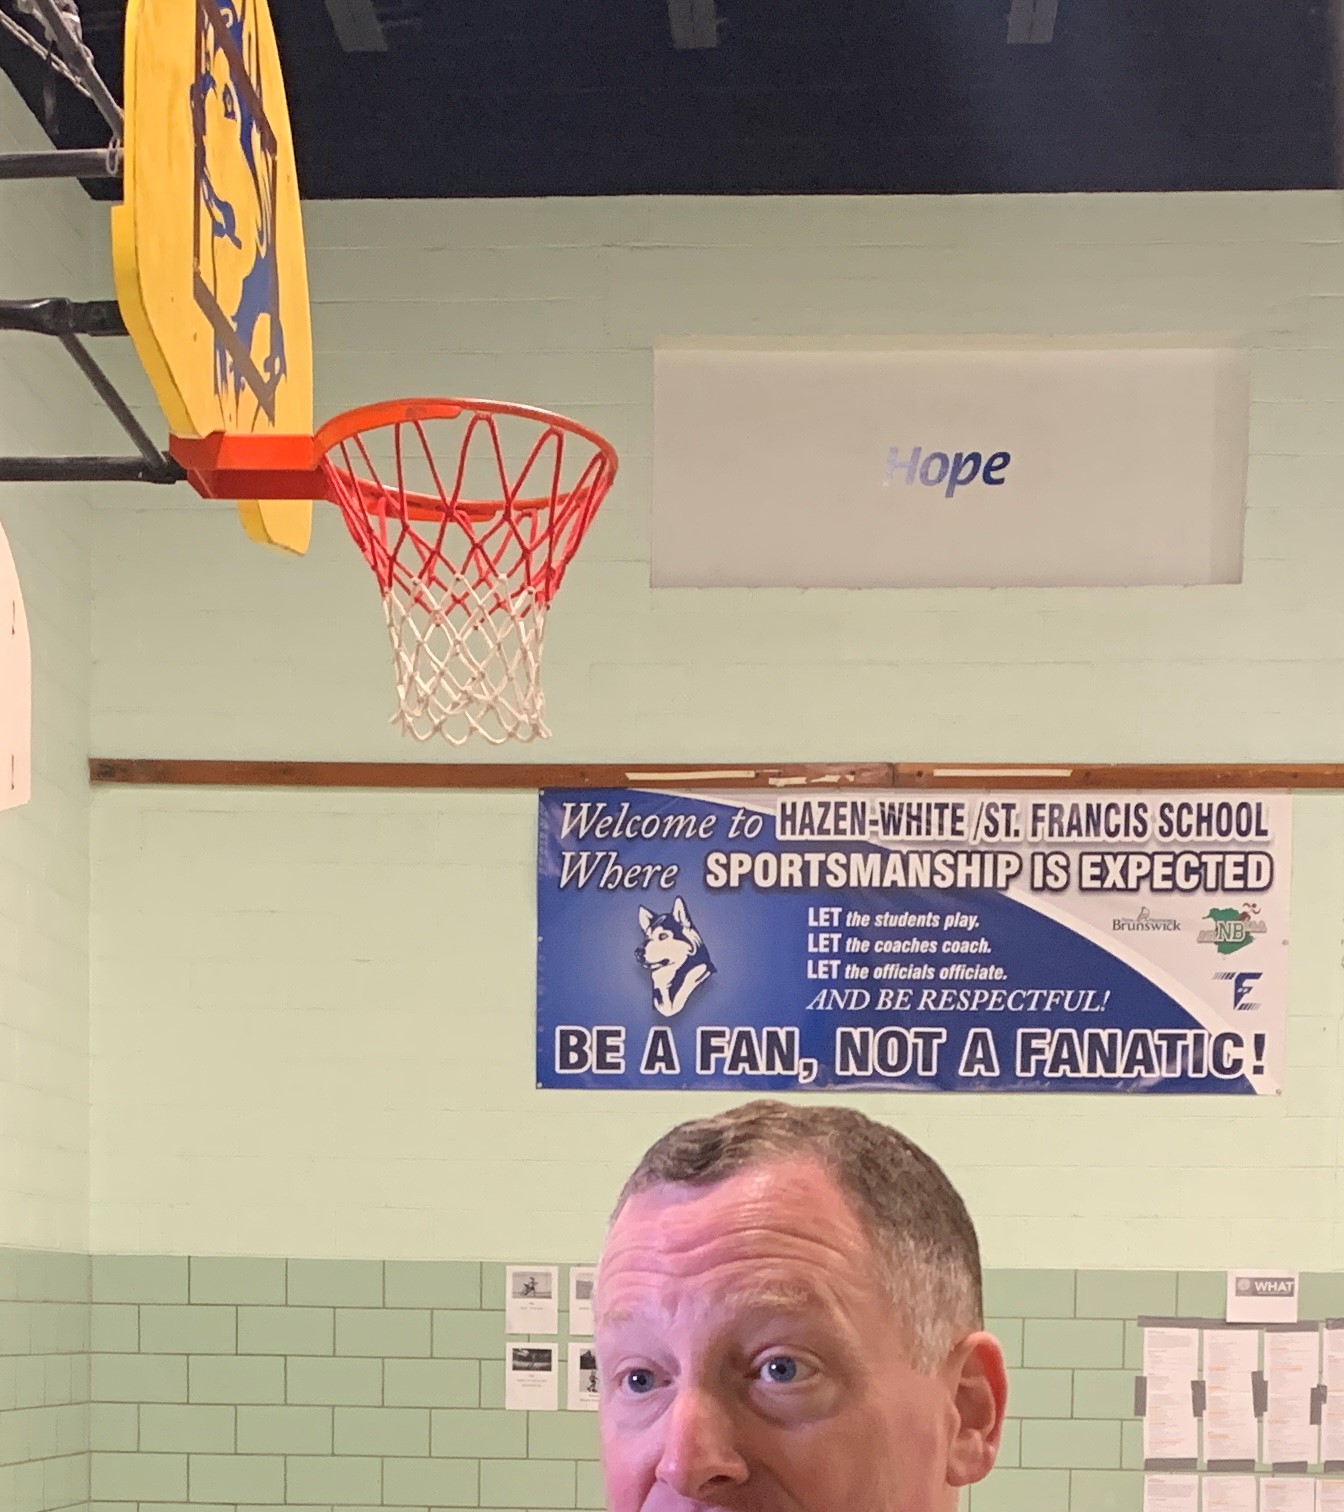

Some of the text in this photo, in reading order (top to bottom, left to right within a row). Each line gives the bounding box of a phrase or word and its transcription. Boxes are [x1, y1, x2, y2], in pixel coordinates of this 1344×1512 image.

[883, 446, 1011, 499] Hope
[561, 802, 717, 840] Welcome
[727, 808, 763, 839] to
[1031, 801, 1148, 839] FRANCIS
[1157, 801, 1269, 839] SCHOOL
[559, 851, 1273, 891] Where SPORTSMANSHIP IS EXPECTED
[808, 907, 980, 931] LET the students play.
[1112, 918, 1182, 931] Brunswick
[807, 933, 992, 954] LET the coaches coach.
[1218, 922, 1244, 941] NB
[807, 960, 1008, 981] LET the officials officiate.
[806, 988, 1111, 1012] AND BE RESPECTFUL!
[556, 1026, 1267, 1084] BE A FAN, NOT A FANATIC!
[1254, 1281, 1293, 1292] WHAT
